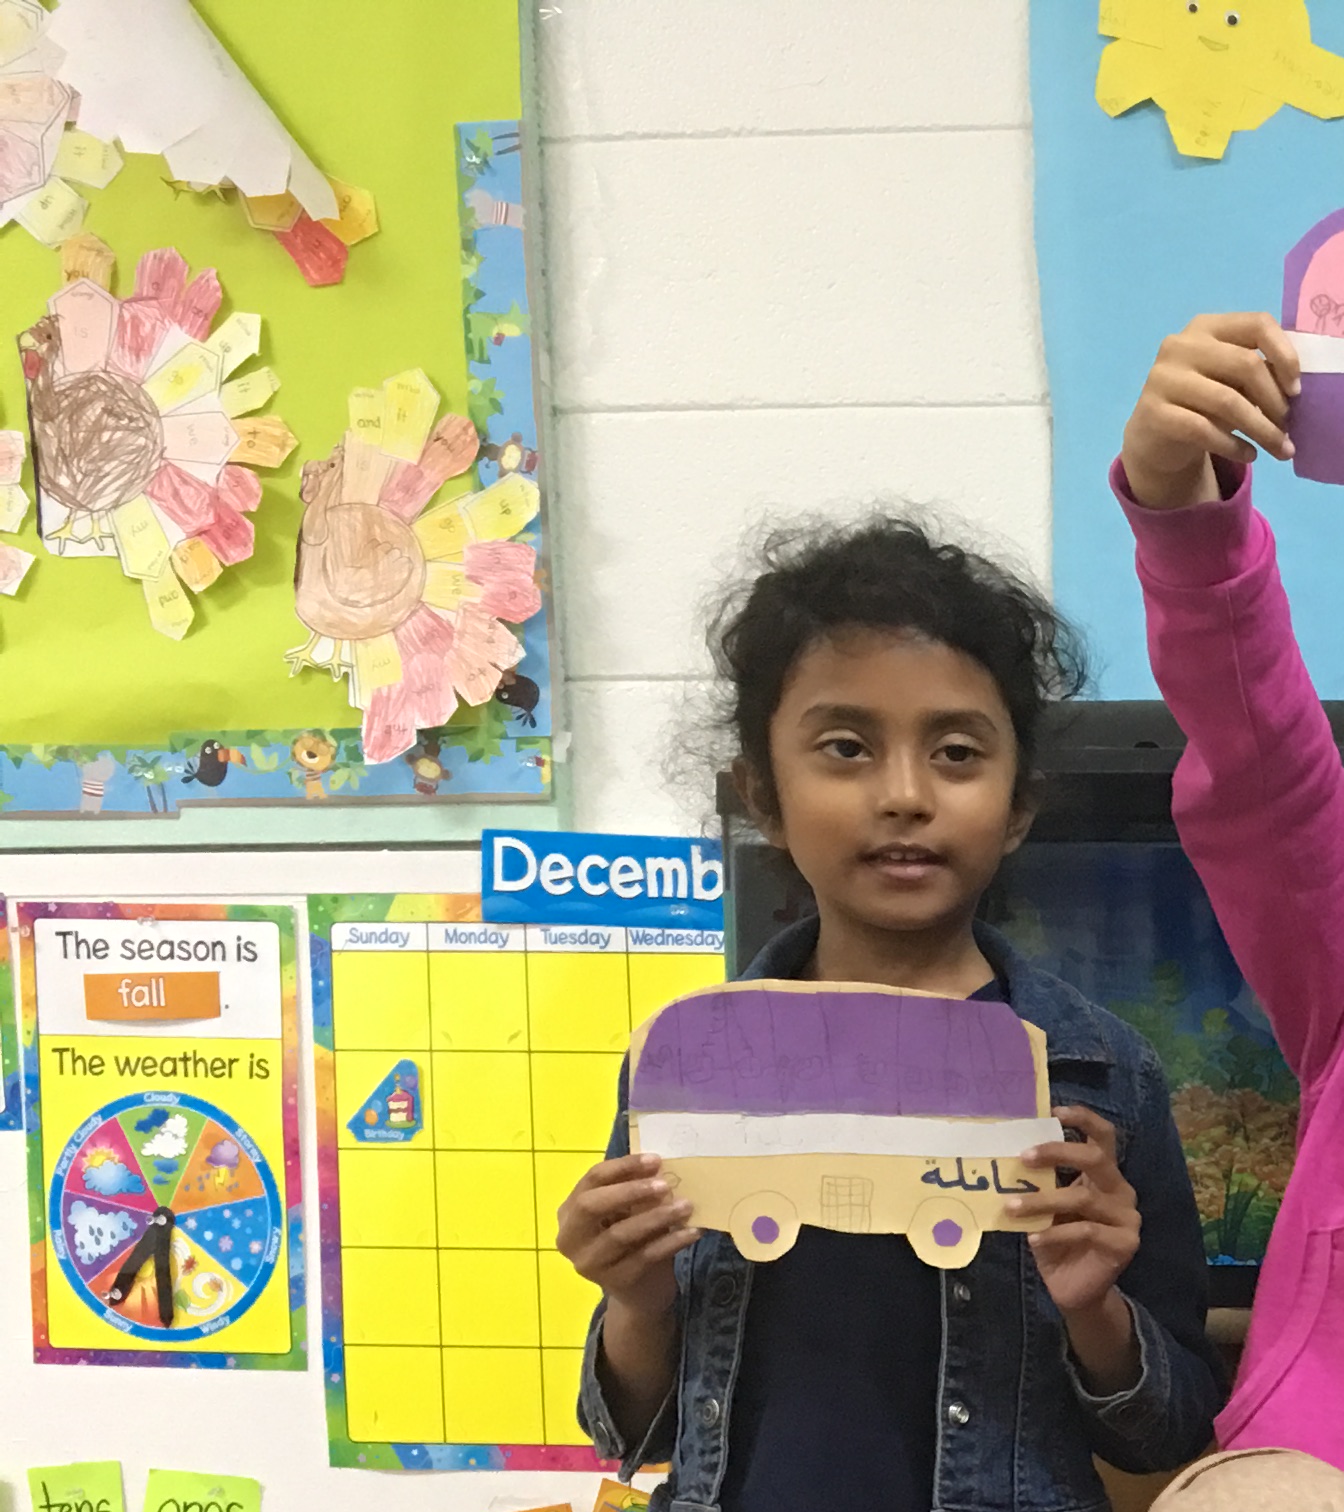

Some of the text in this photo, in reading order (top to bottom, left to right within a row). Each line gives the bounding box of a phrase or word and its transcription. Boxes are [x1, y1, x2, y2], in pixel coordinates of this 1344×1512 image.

[492, 837, 724, 901] Decemb
[55, 931, 258, 962] The season is
[348, 928, 411, 948] Sunday
[444, 929, 510, 948] Monday
[540, 929, 612, 949] Tuesday
[629, 930, 726, 949] Wednesday
[118, 977, 166, 1007] fall
[51, 1047, 270, 1080] The weather is
[143, 1092, 181, 1104] Cloudy
[920, 1157, 1040, 1194] حافلة
